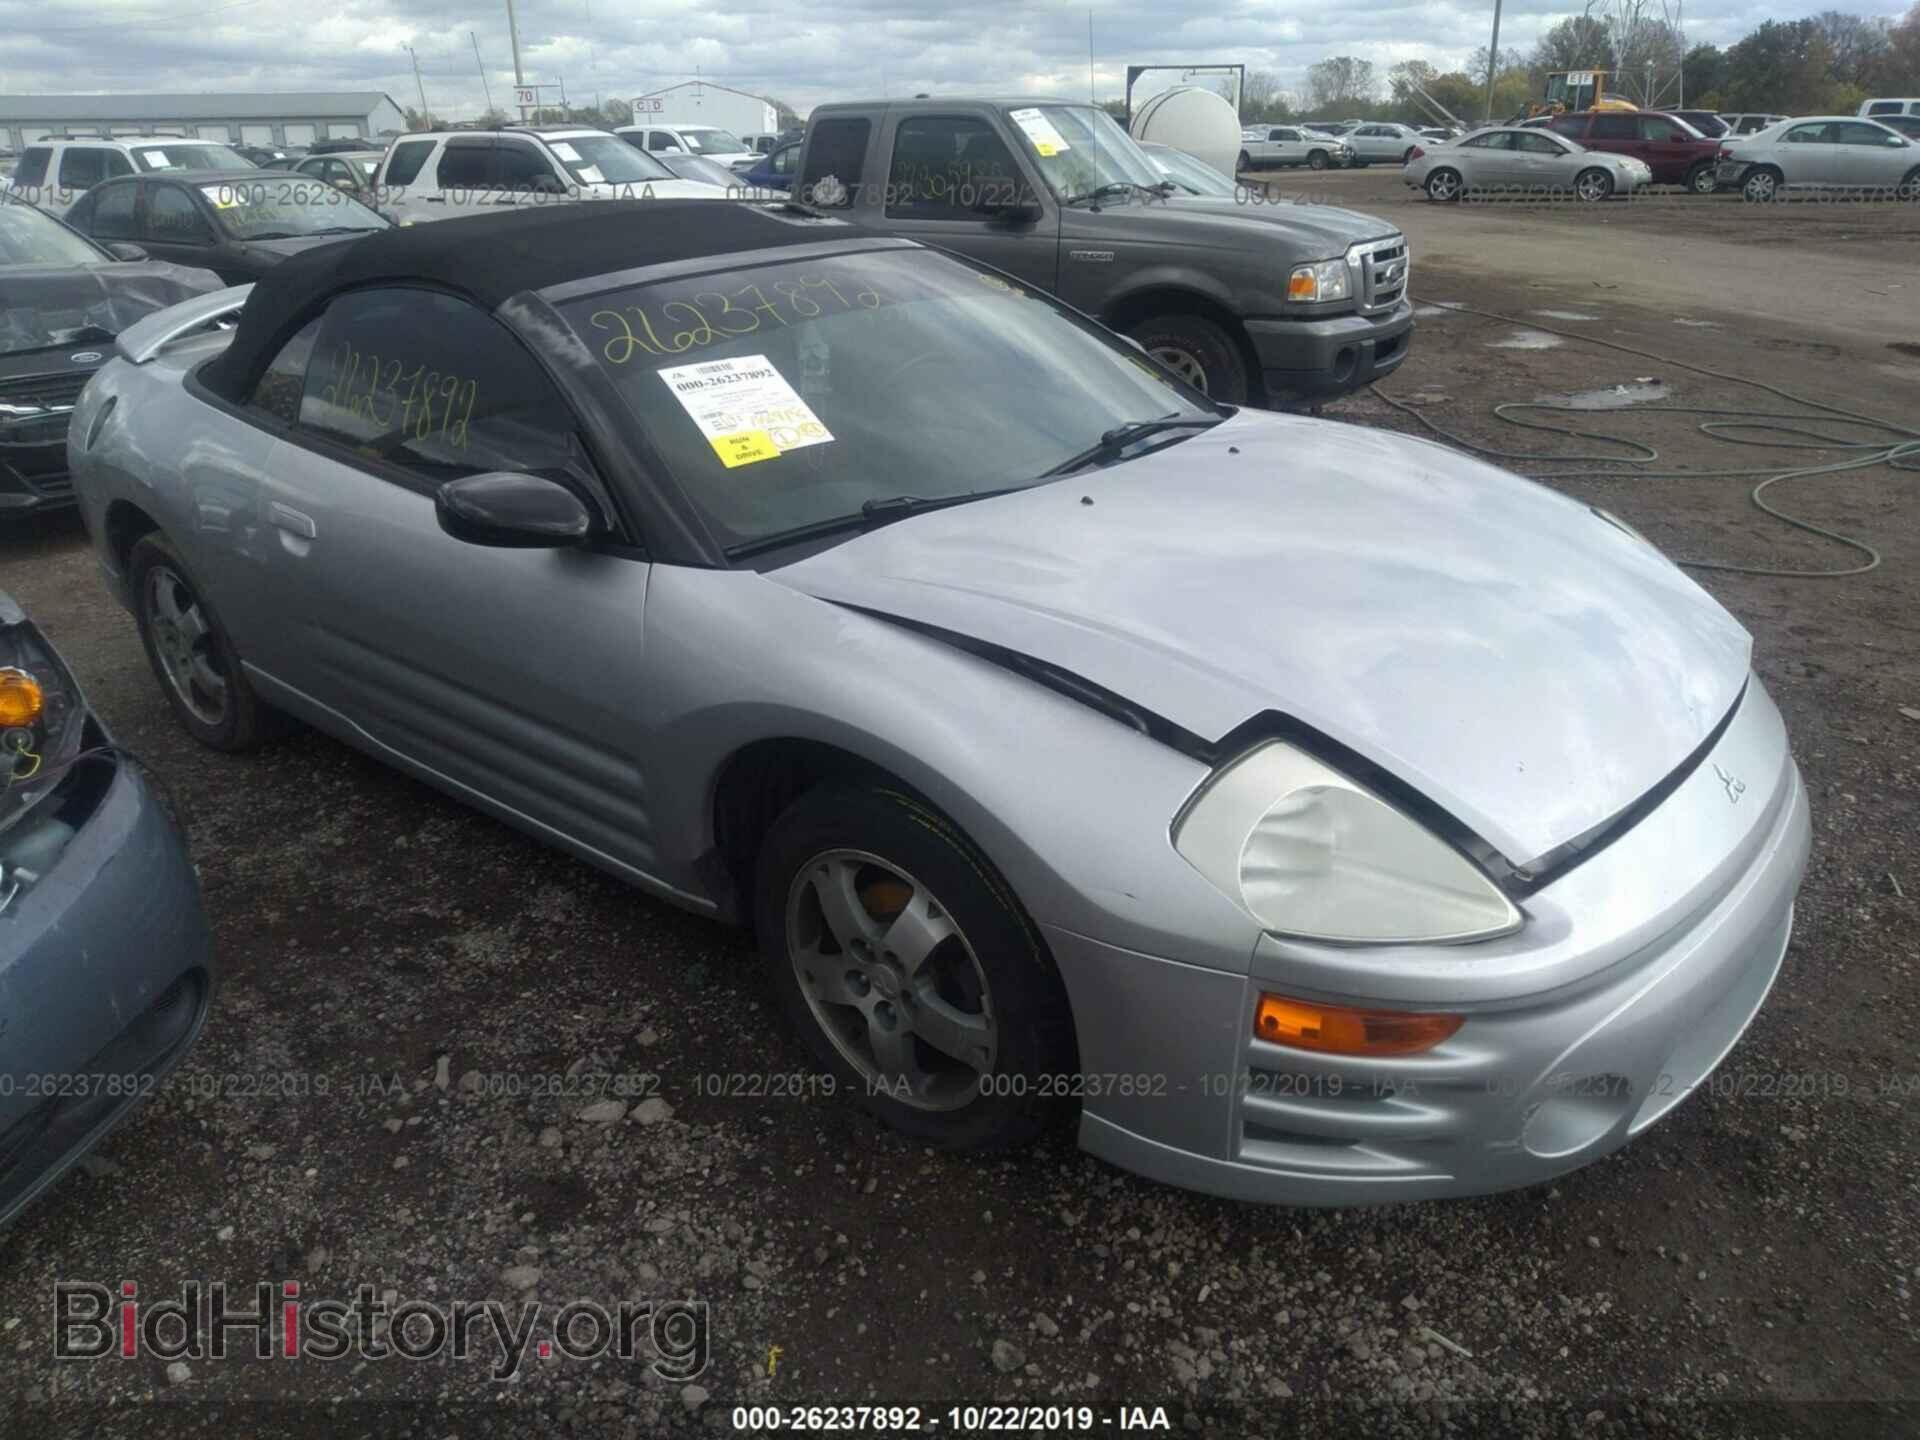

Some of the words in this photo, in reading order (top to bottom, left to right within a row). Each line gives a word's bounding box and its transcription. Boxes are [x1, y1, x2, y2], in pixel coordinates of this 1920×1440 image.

[518, 91, 532, 102] 70
[591, 275, 881, 363] 26237892
[676, 369, 775, 393] 000-26237892
[322, 340, 478, 450] 26237892
[729, 436, 750, 445] RUN
[735, 449, 764, 461] DRIVE
